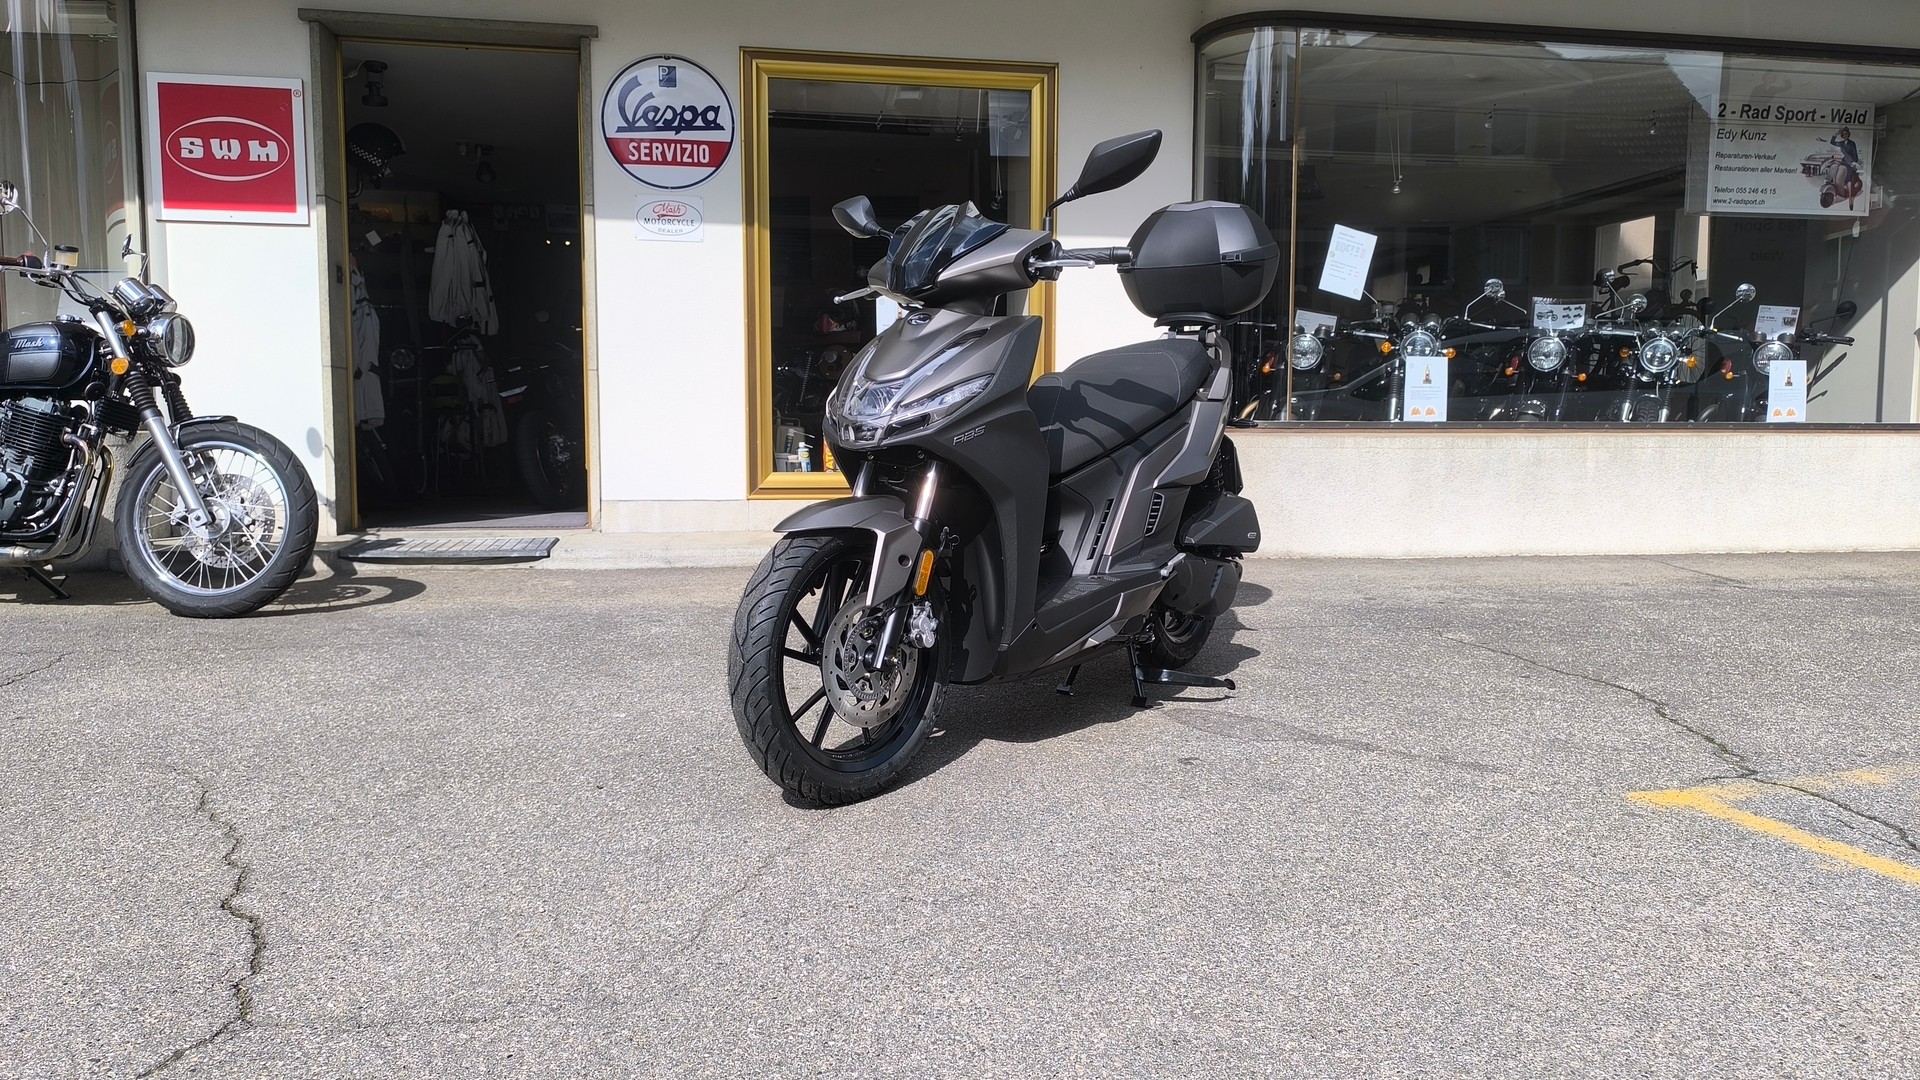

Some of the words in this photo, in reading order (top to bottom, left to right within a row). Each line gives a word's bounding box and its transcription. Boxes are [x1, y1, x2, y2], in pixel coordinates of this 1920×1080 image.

[615, 75, 726, 136] Vespa
[1717, 102, 1727, 118] 2
[1739, 103, 1771, 120] Rad
[1774, 104, 1818, 124] Sport
[1831, 107, 1868, 124] Wald
[1716, 128, 1738, 143] Edy
[1740, 129, 1767, 141] Kunz
[179, 137, 279, 162] SWM
[628, 142, 710, 164] SERVIZIO
[1714, 186, 1735, 194] Telefon
[652, 202, 687, 217] Mash
[643, 217, 695, 227] MOTORCYCLE
[14, 337, 44, 349] Mash
[952, 425, 986, 446] ABS
